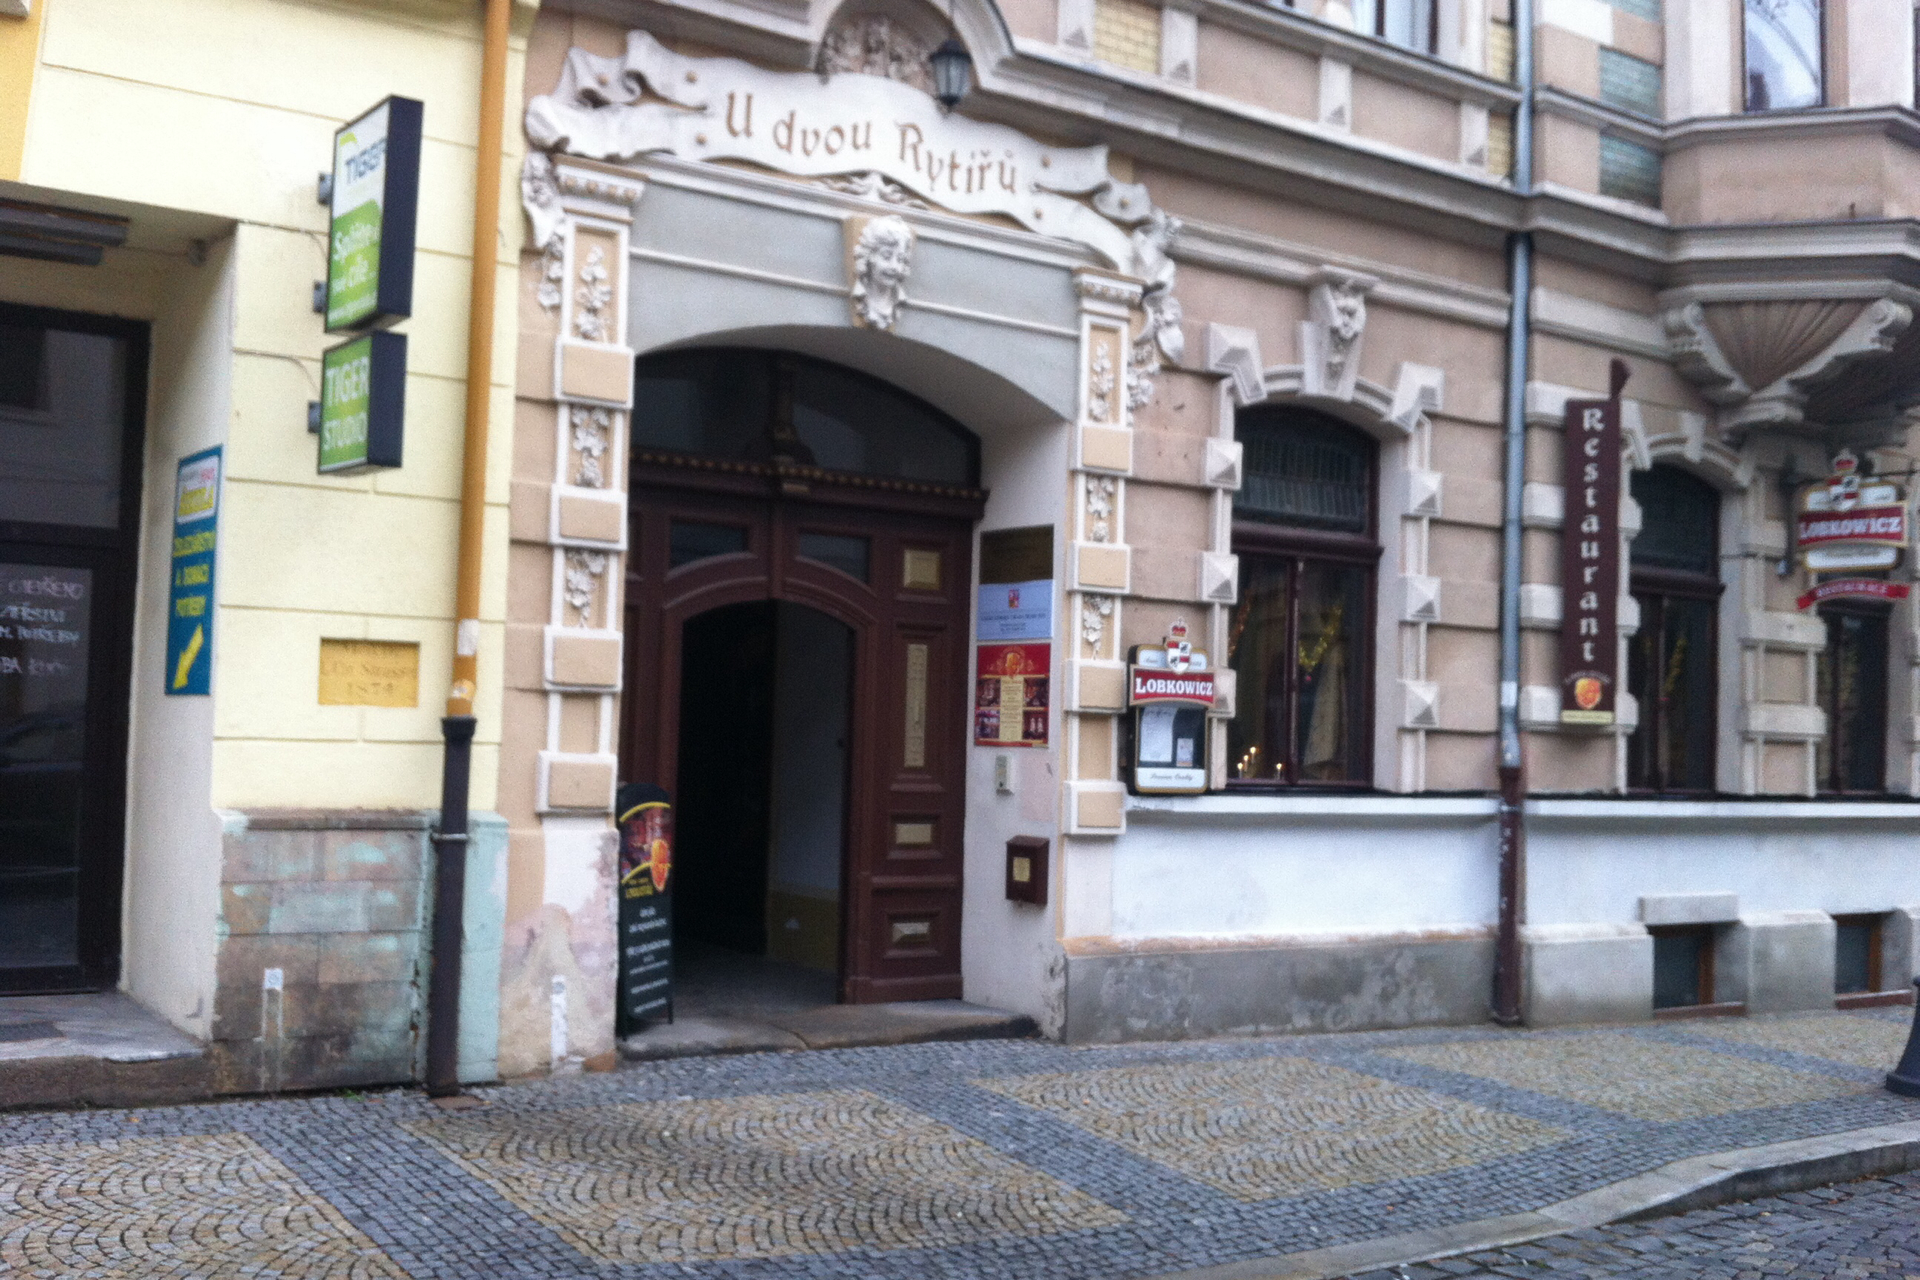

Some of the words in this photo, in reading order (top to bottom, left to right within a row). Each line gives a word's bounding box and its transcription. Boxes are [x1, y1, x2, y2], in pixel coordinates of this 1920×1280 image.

[726, 92, 753, 137] U
[772, 110, 872, 157] dvou
[895, 120, 1016, 195] Rytířů
[325, 356, 369, 406] TIGER
[323, 411, 367, 451] STUDIO
[1579, 408, 1604, 662] Restaurant
[1135, 677, 1213, 696] LOBKOWICZ
